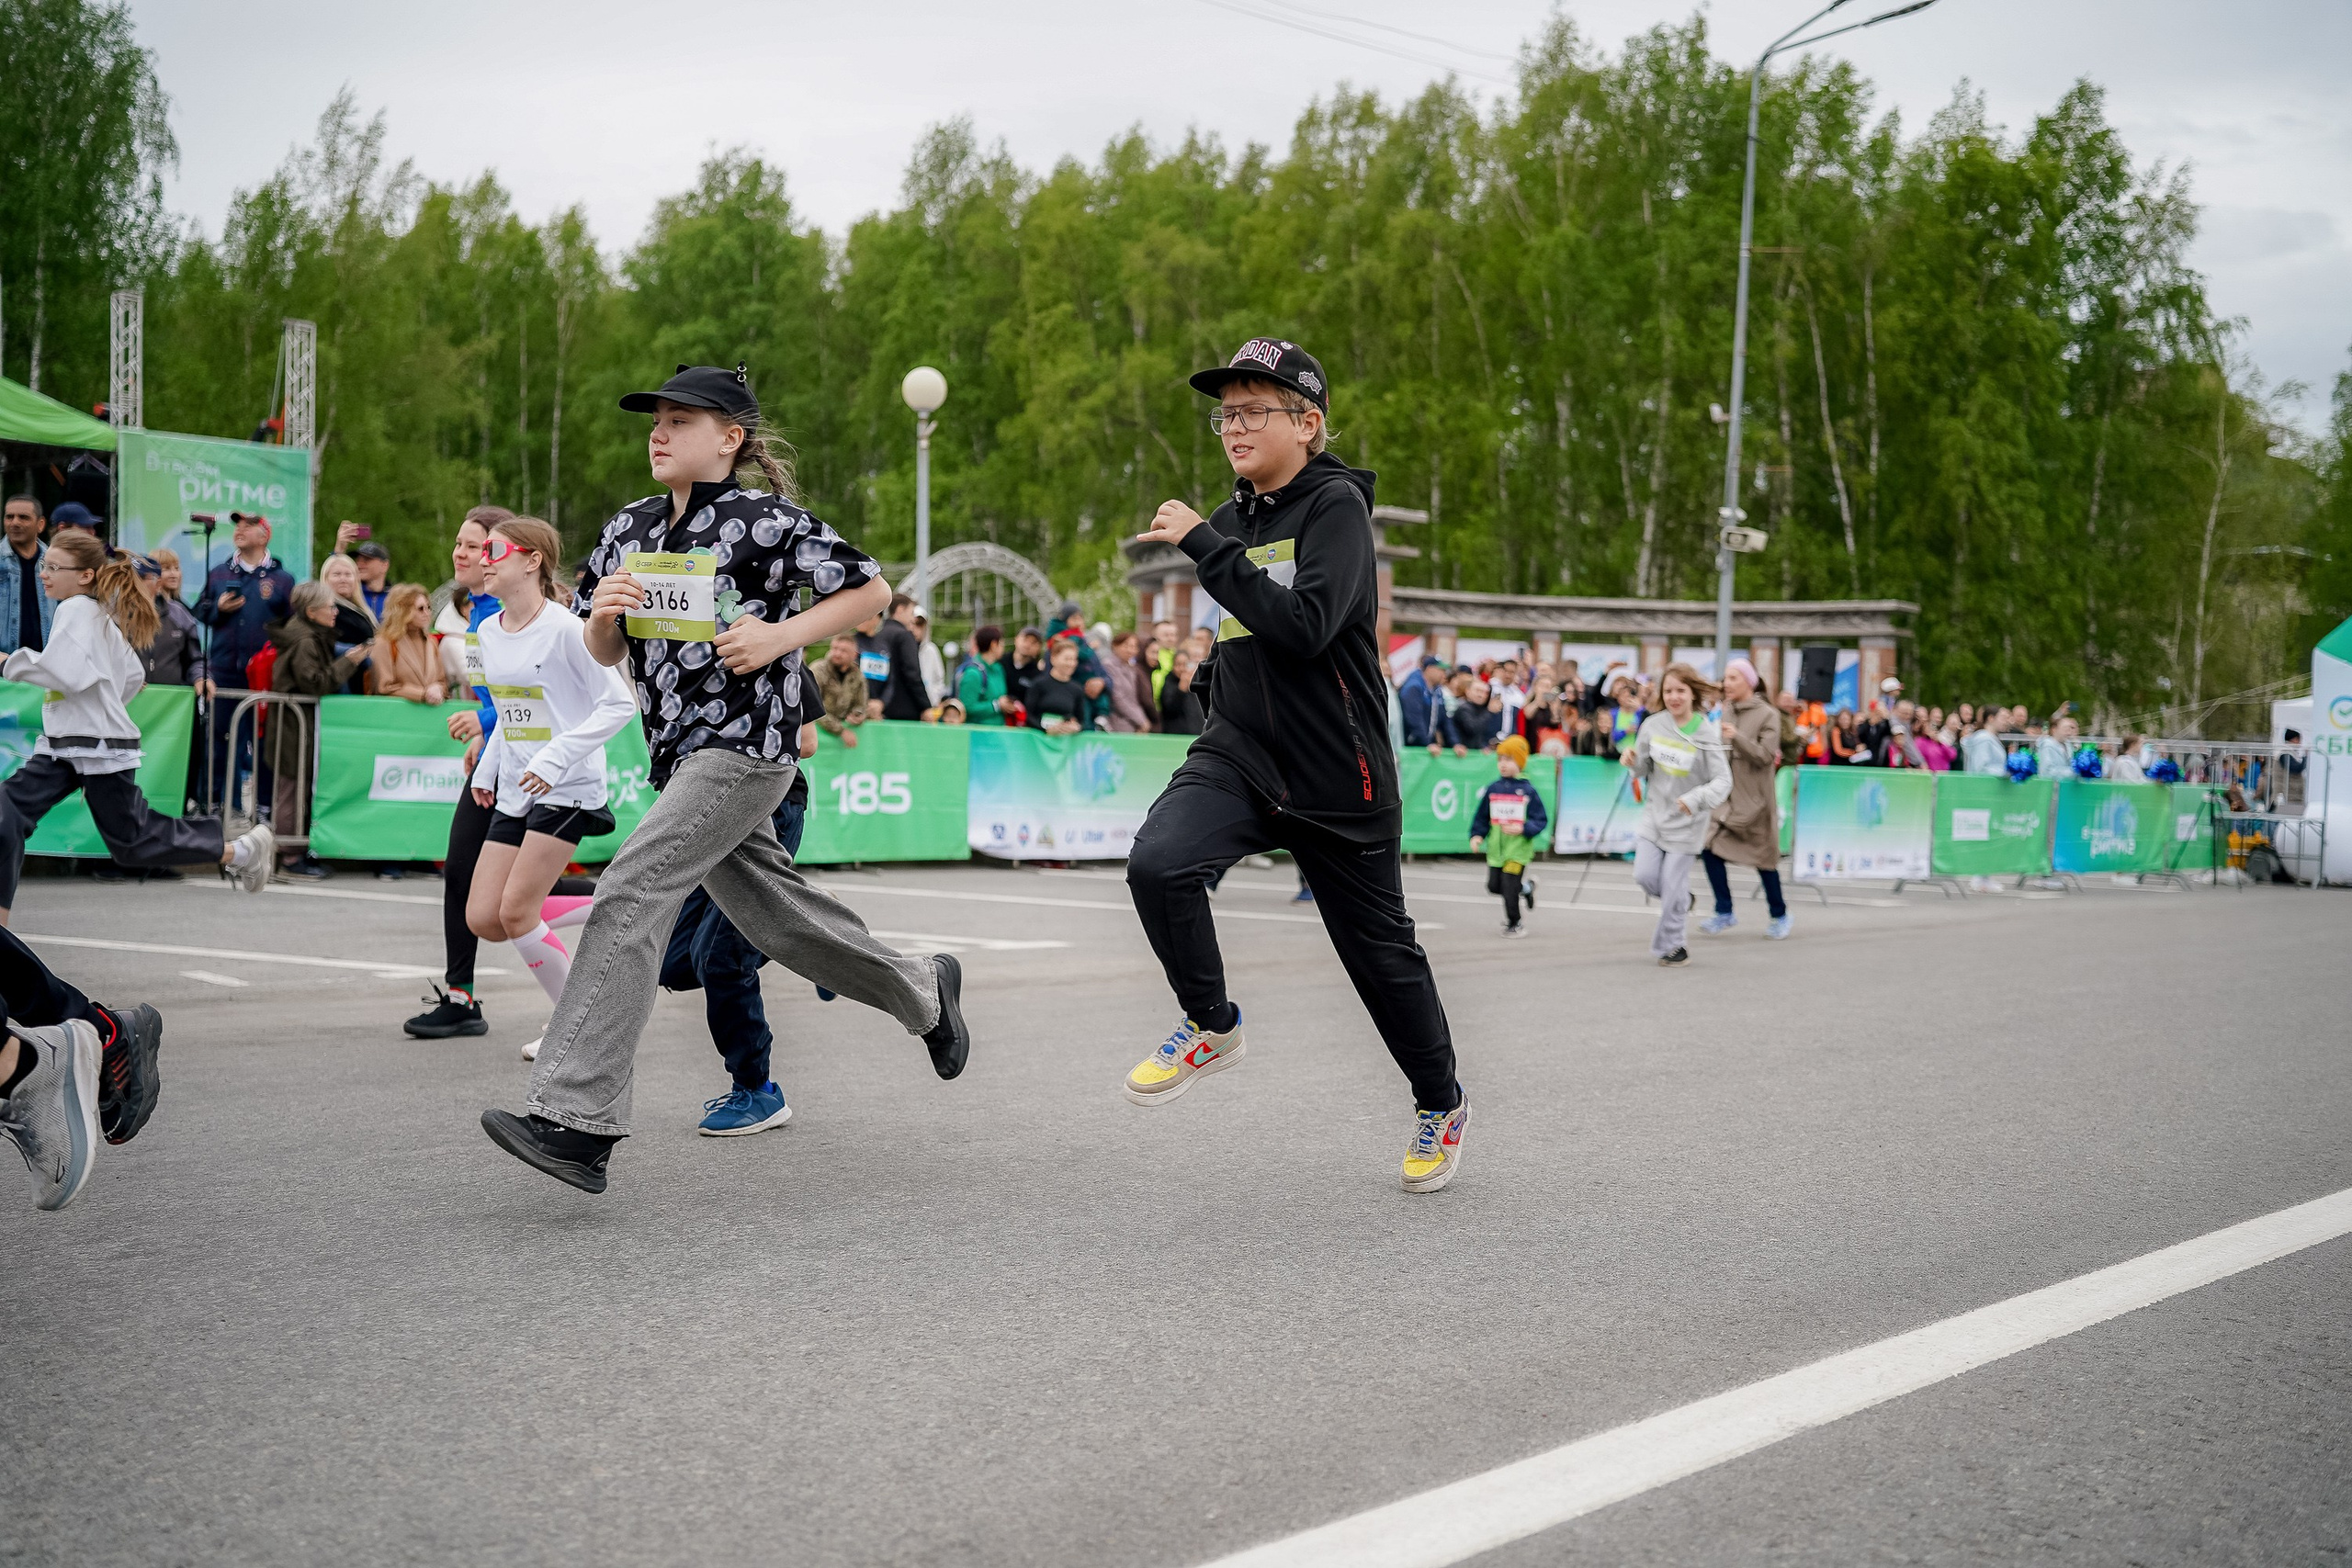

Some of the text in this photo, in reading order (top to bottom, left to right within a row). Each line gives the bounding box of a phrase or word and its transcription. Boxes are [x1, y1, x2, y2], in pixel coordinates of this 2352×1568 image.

[179, 476, 287, 516] ритме
[642, 590, 689, 612] 3166
[502, 708, 532, 723] 139
[1353, 735, 1373, 801] SCUDERIA
[830, 771, 912, 816] 185
